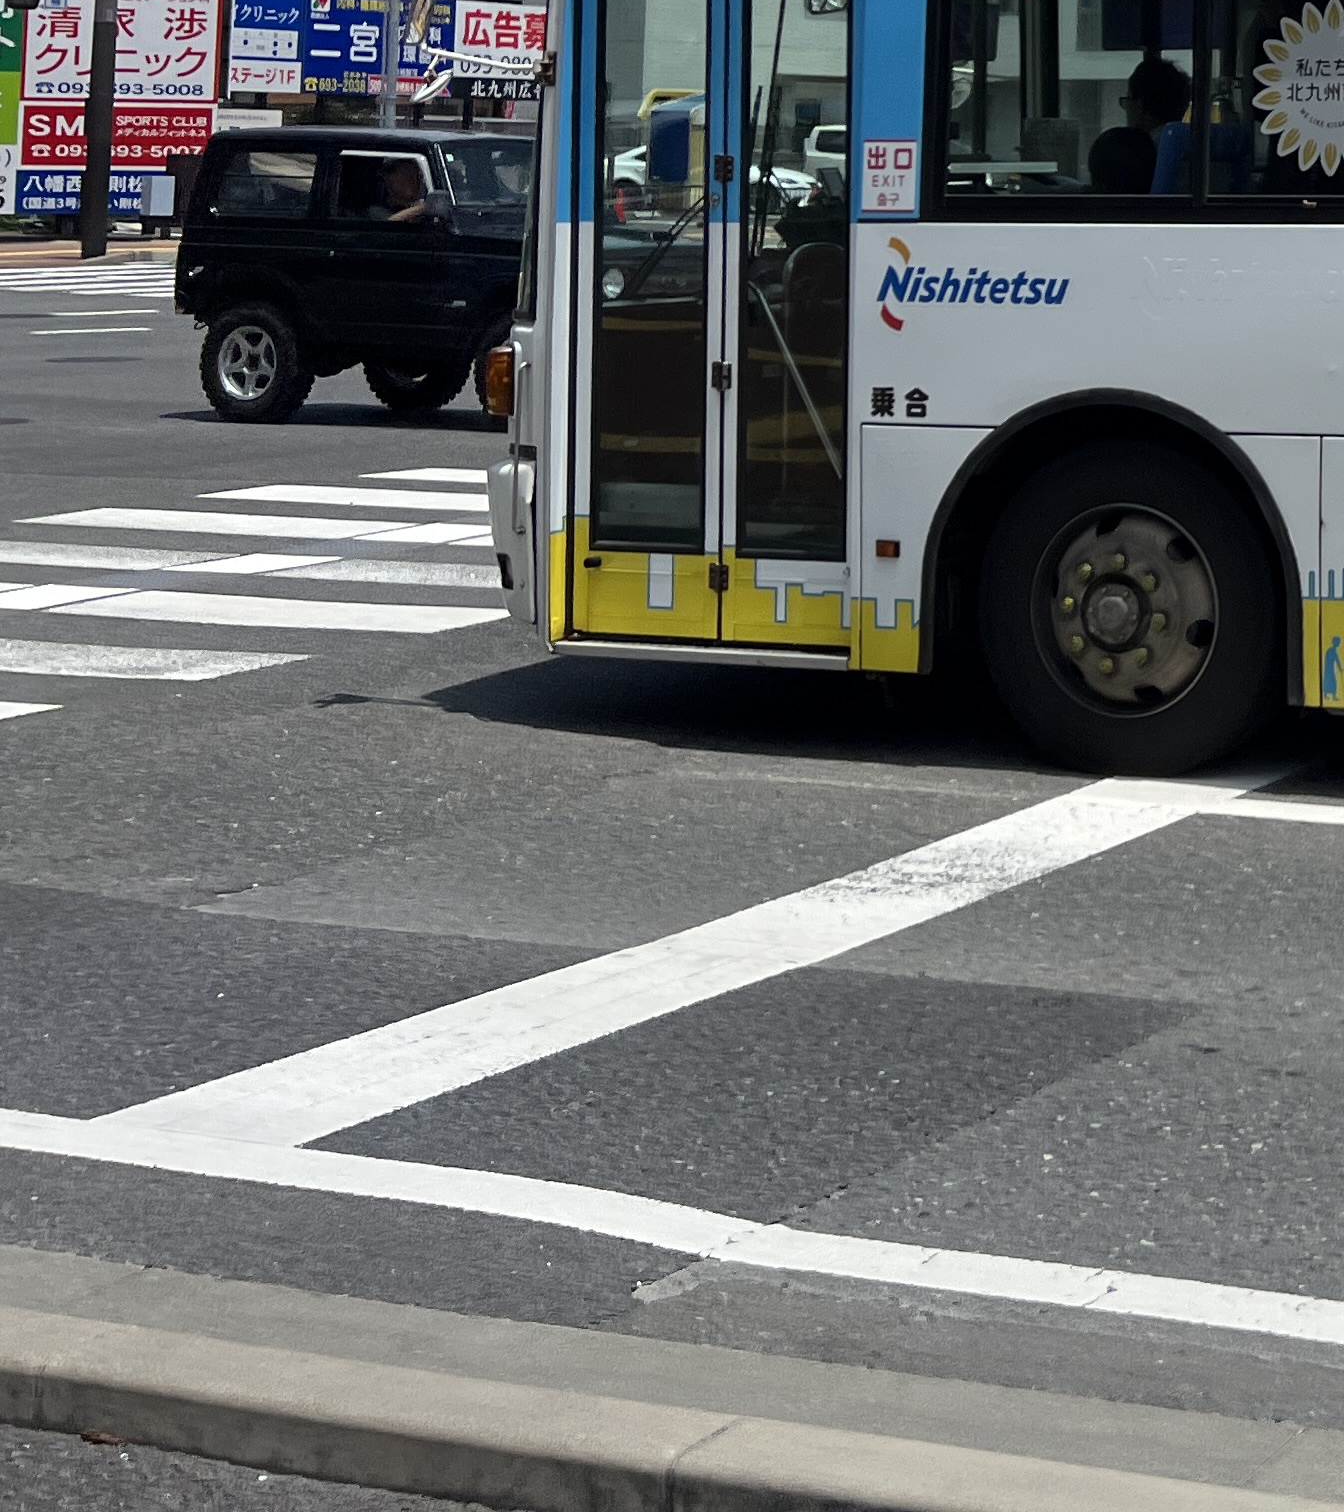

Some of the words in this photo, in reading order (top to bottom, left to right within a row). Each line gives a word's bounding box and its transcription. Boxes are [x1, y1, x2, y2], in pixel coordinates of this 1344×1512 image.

[116, 115, 169, 127] SPORTS
[172, 115, 208, 127] CLUB
[867, 144, 913, 170] 出口
[871, 174, 906, 188] EXIT
[876, 264, 1070, 306] Nishitetsu
[871, 386, 929, 418] 乗合
